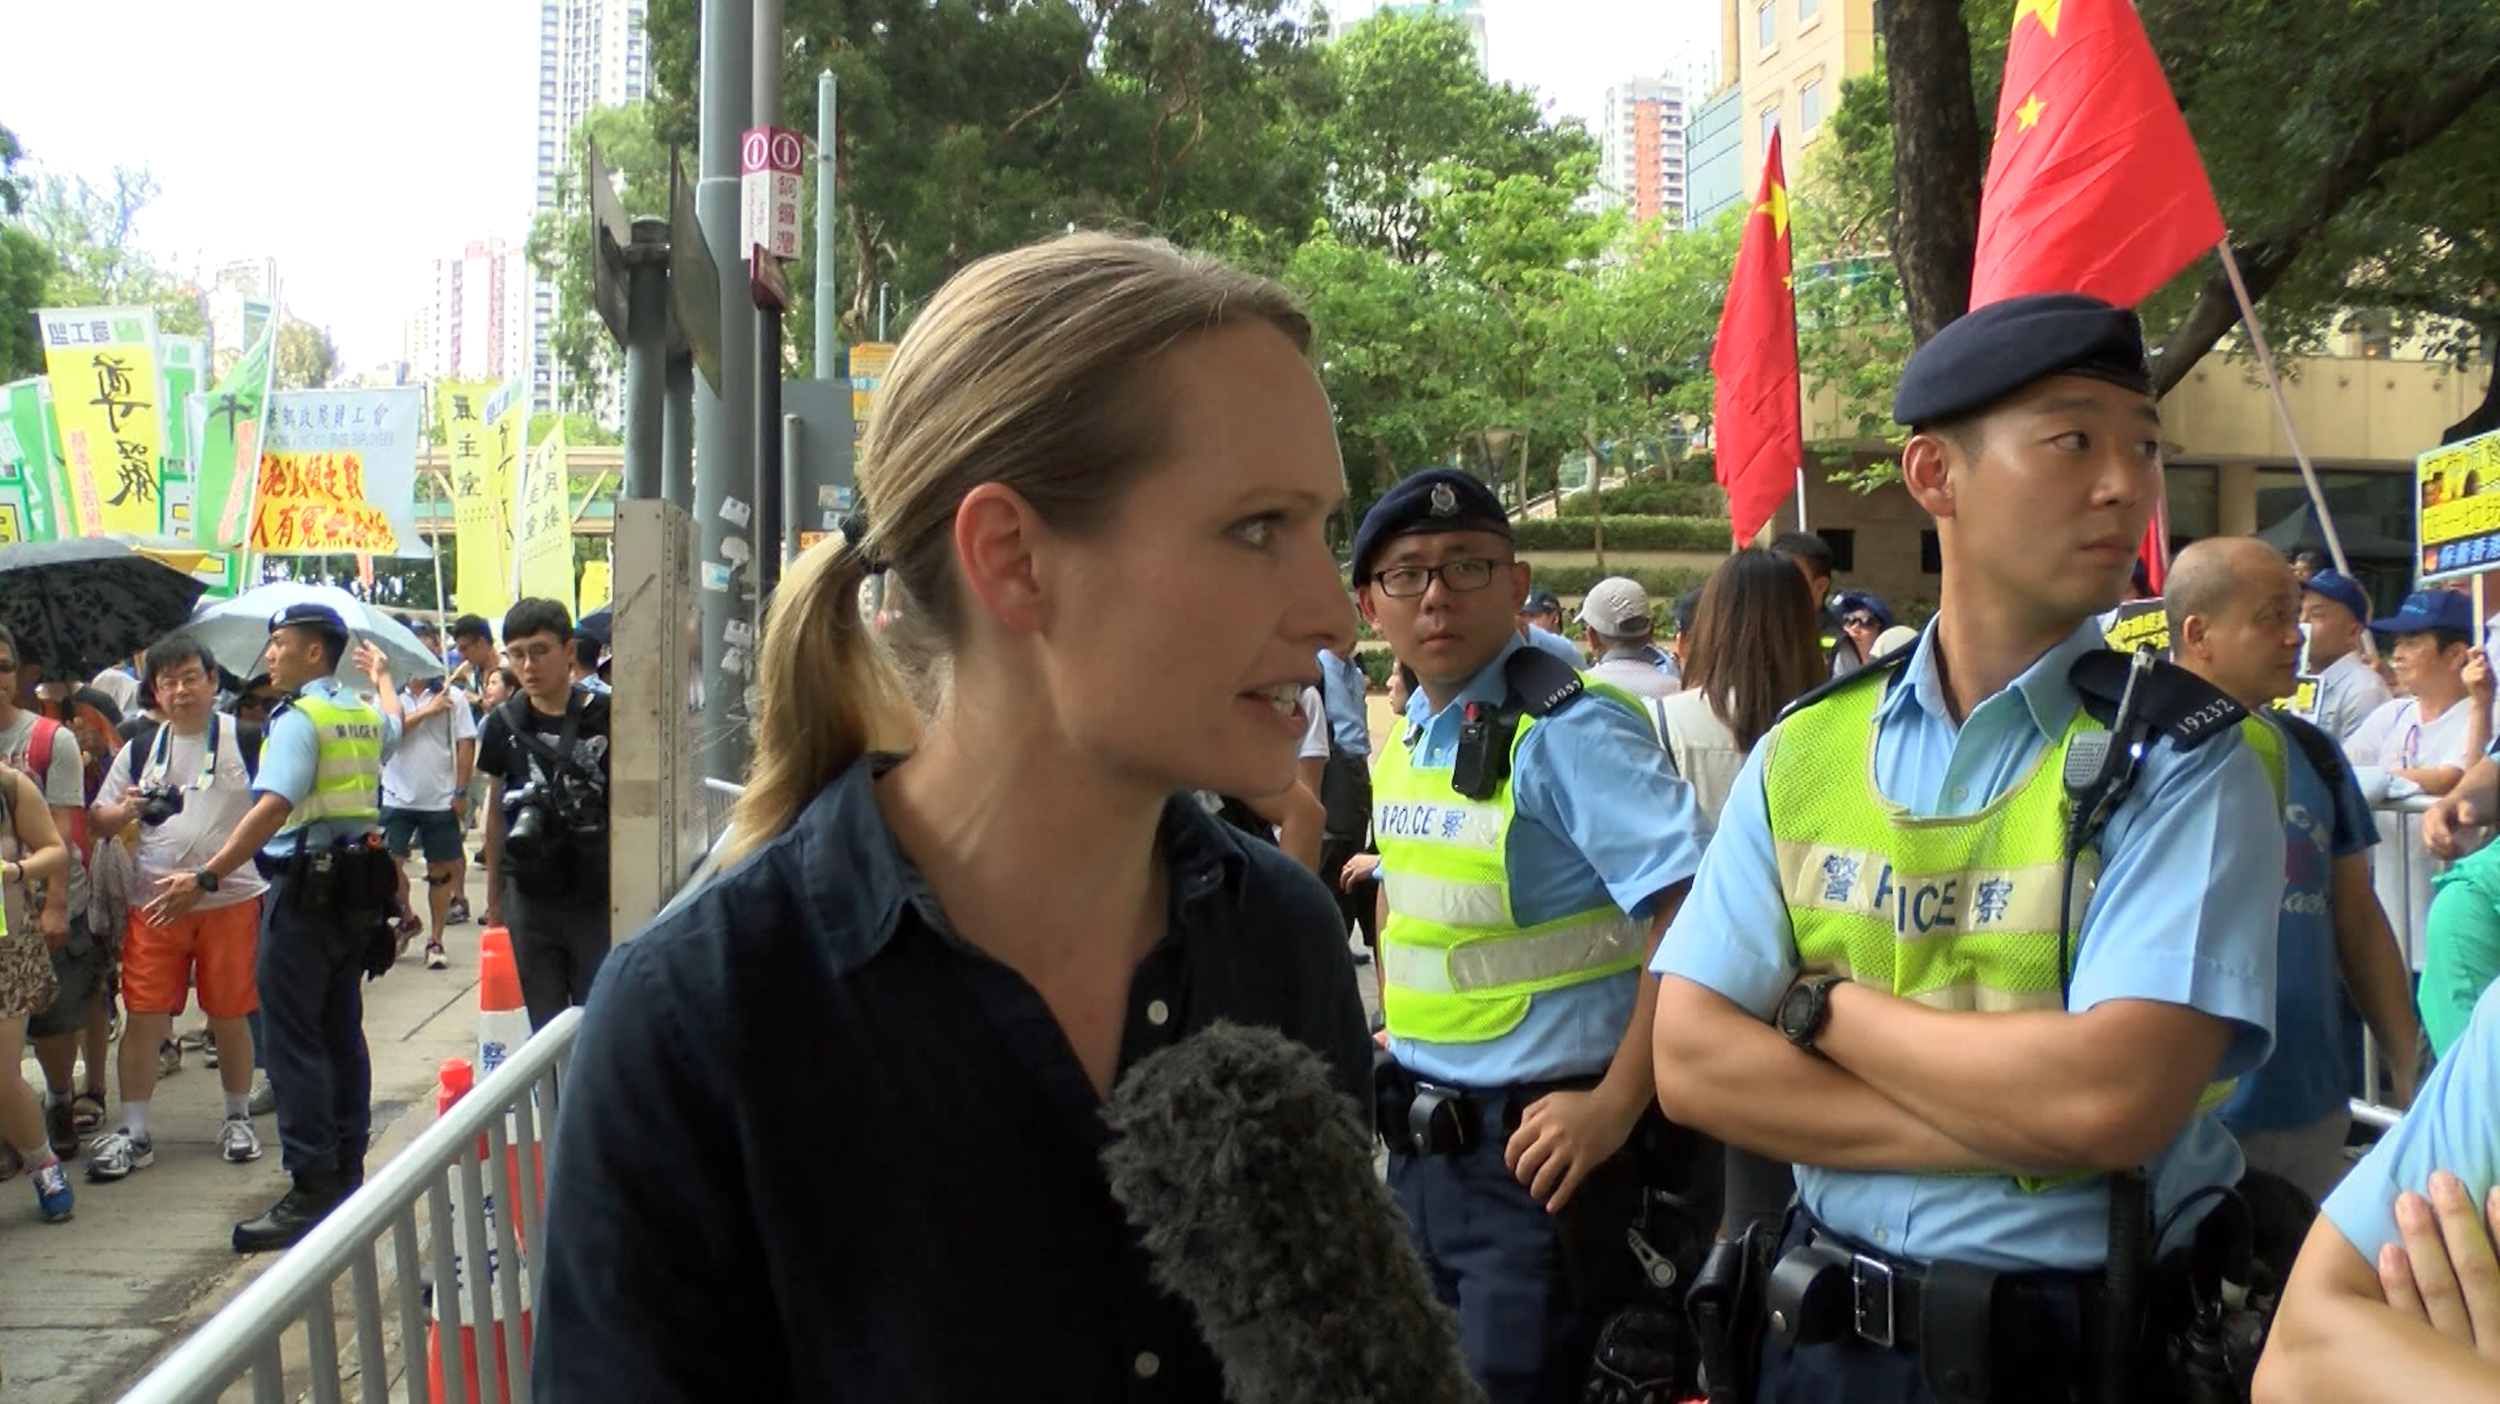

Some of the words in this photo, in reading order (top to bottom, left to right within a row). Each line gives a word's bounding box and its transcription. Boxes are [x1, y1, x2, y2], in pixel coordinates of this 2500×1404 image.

[2176, 698, 2235, 736] 19232
[1822, 854, 1860, 902] 警
[1976, 876, 2013, 923] 察
